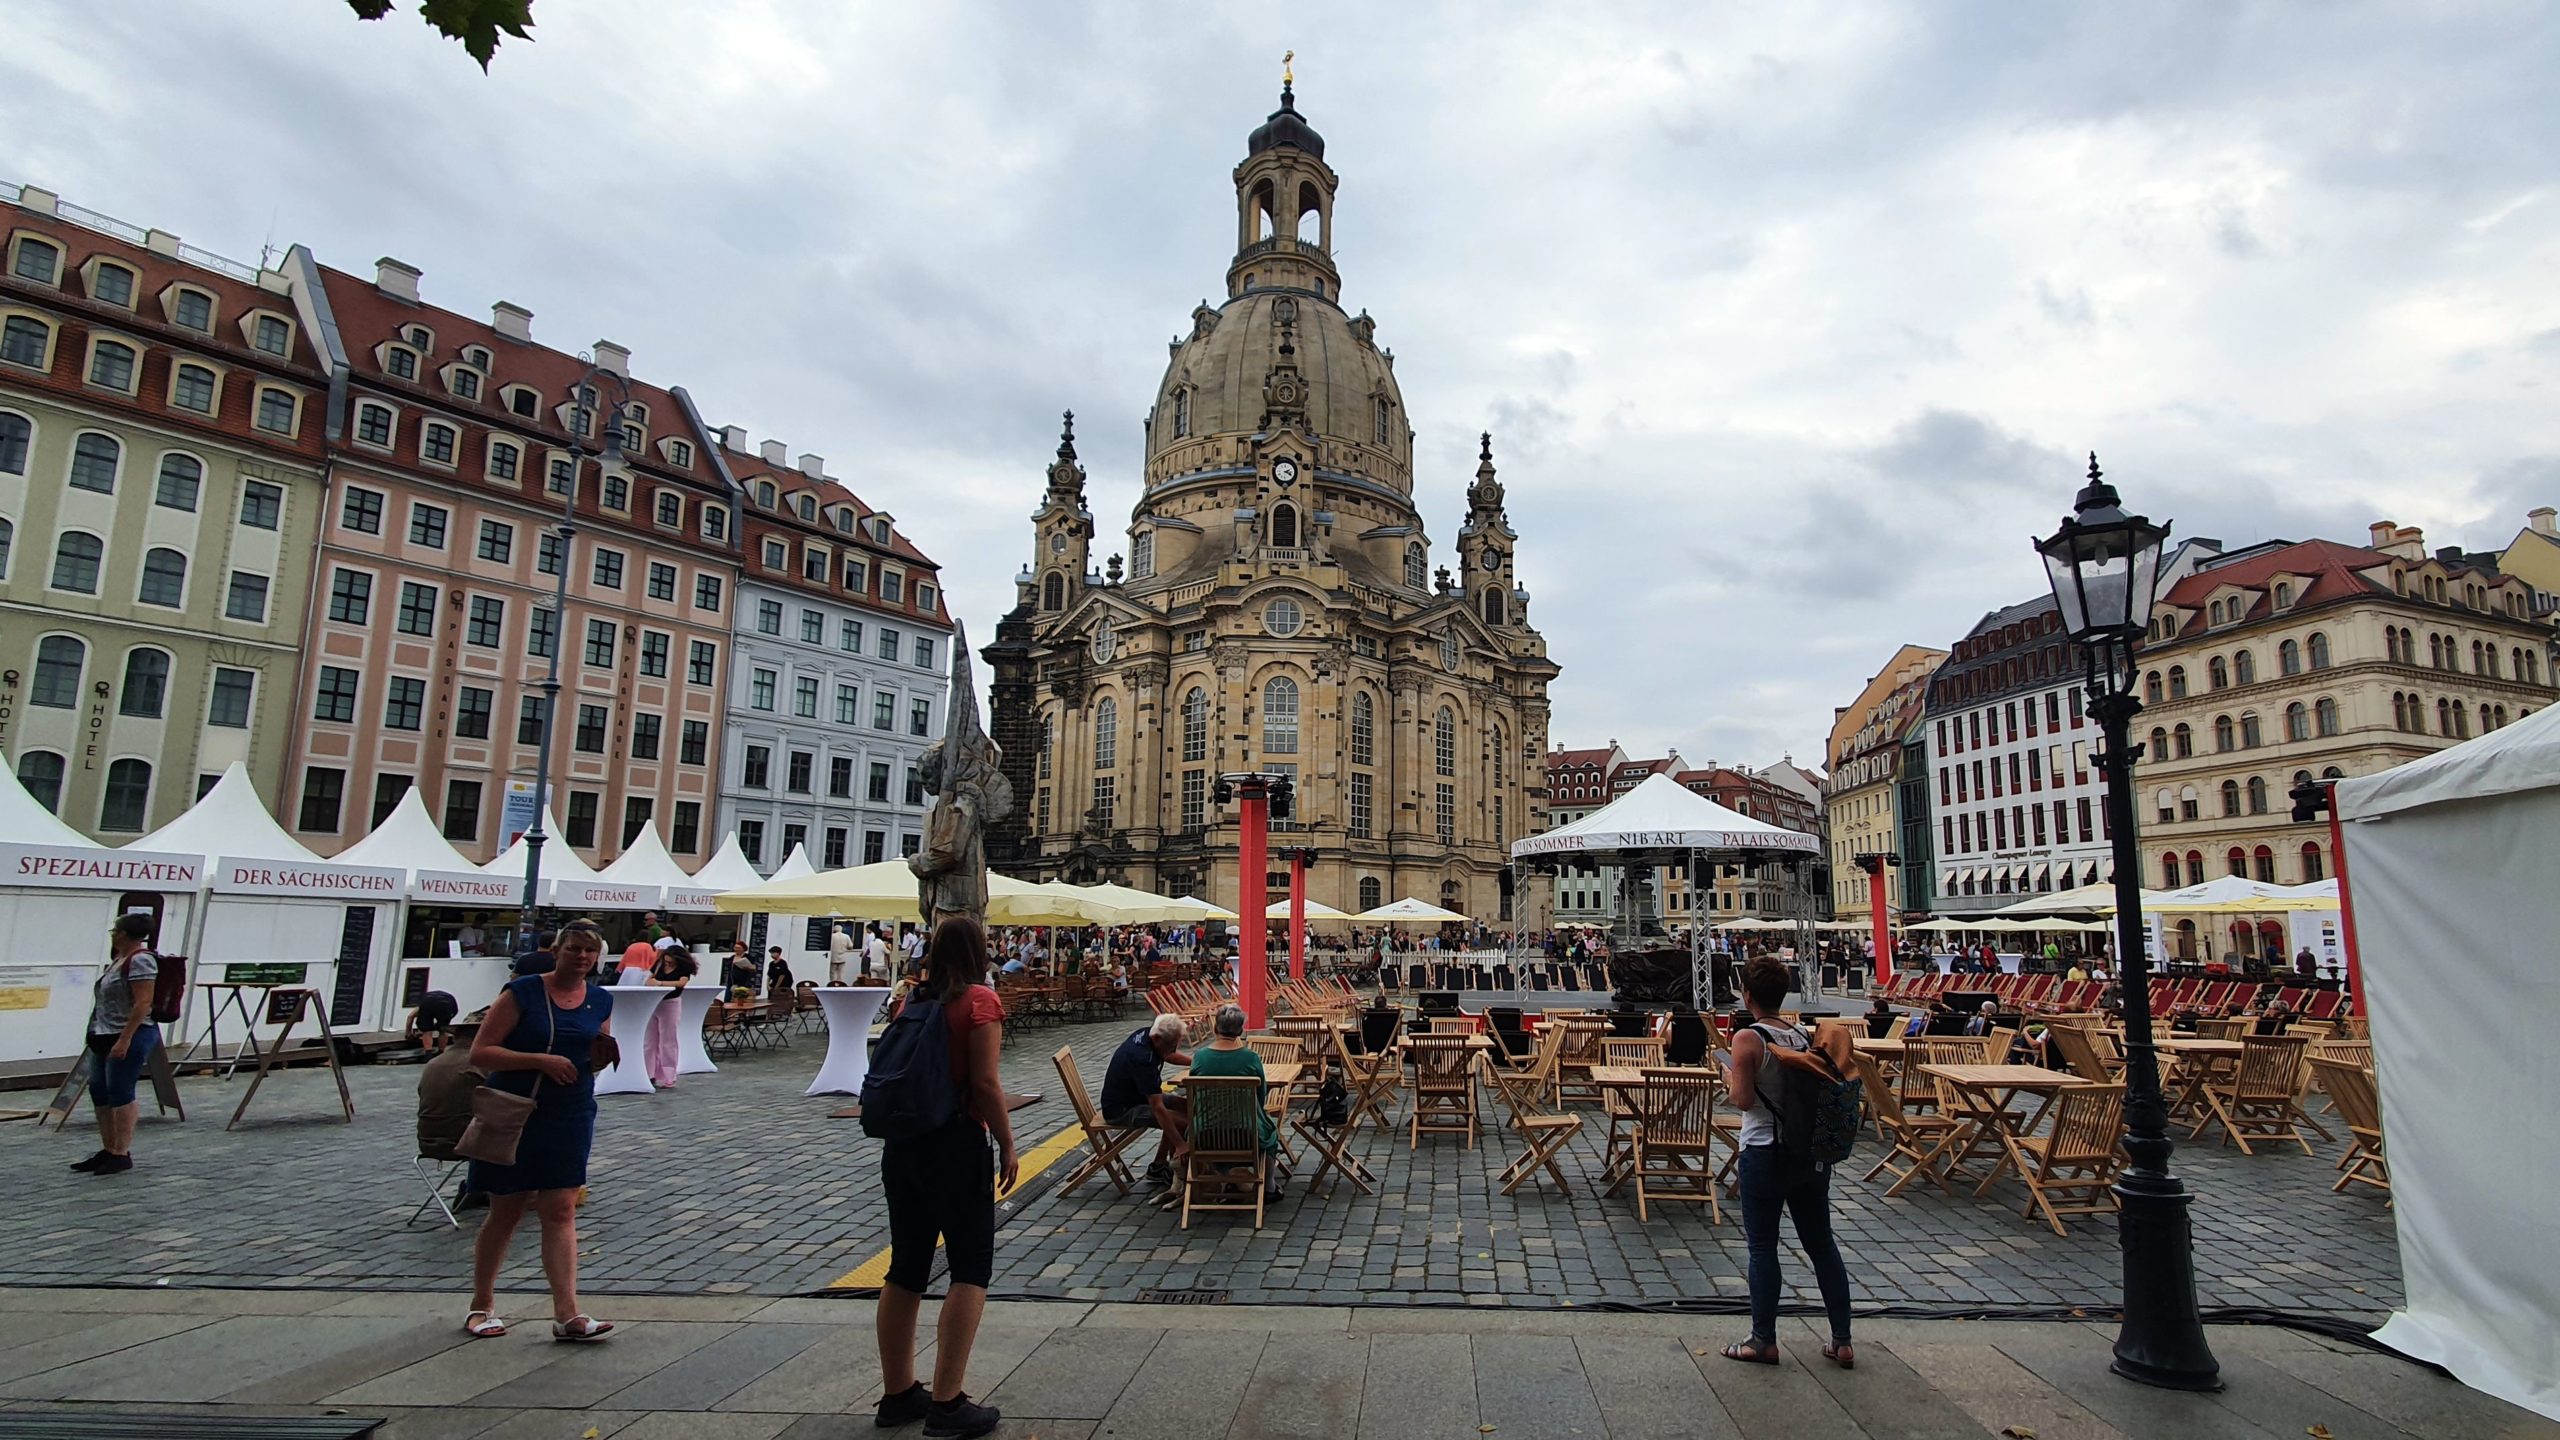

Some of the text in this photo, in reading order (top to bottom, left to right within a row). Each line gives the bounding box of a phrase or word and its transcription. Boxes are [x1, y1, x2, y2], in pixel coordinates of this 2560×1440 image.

[437, 622, 457, 738] PASSAGE
[84, 704, 105, 770] HOTEL
[1533, 835, 1586, 853] SOMMER
[1619, 831, 1687, 846] NIB ART
[1723, 833, 1770, 847] PALAIS
[17, 855, 196, 882] SPEZIALITÄTEN
[233, 868, 395, 891] DER SÄCHSISCHEN
[421, 879, 509, 897] WEINSTRASSE
[690, 895, 716, 906] KAFFE
